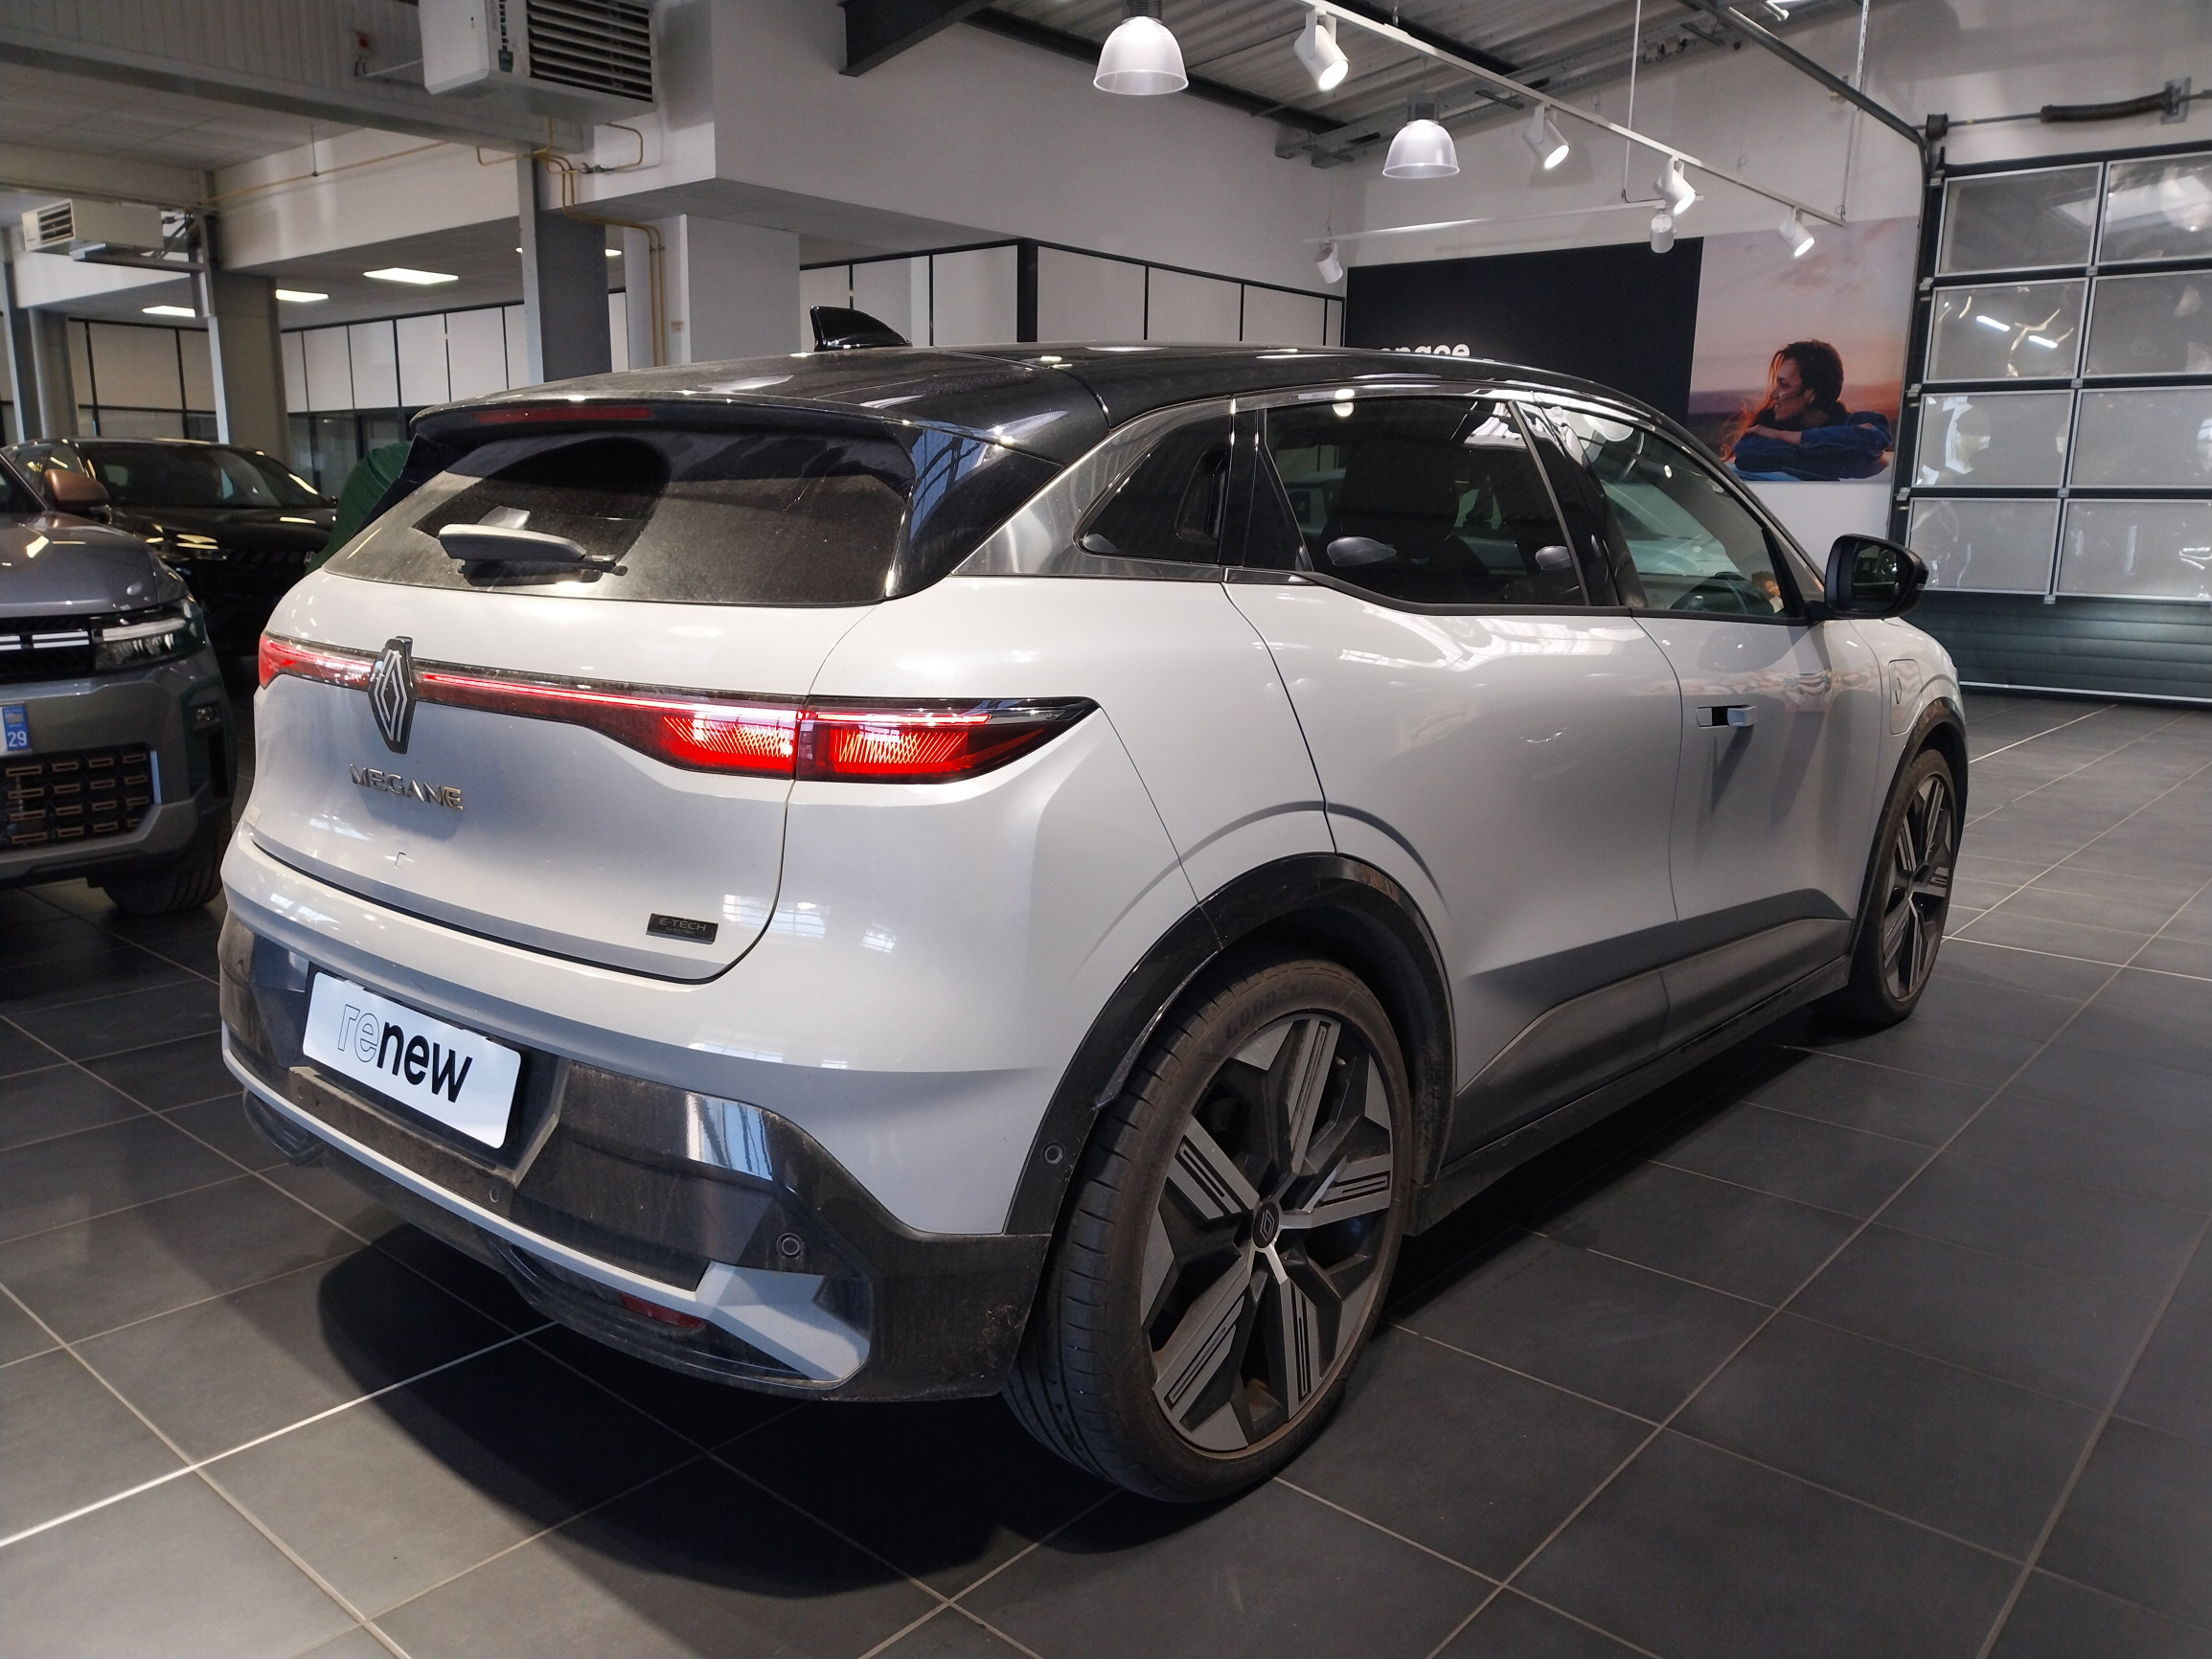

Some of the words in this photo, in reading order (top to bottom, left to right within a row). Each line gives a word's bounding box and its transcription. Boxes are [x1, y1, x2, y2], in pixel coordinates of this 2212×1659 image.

[7, 730, 28, 748] 29
[349, 763, 466, 811] MEGANE
[658, 917, 707, 932] E-TECH
[337, 1003, 473, 1103] renew
